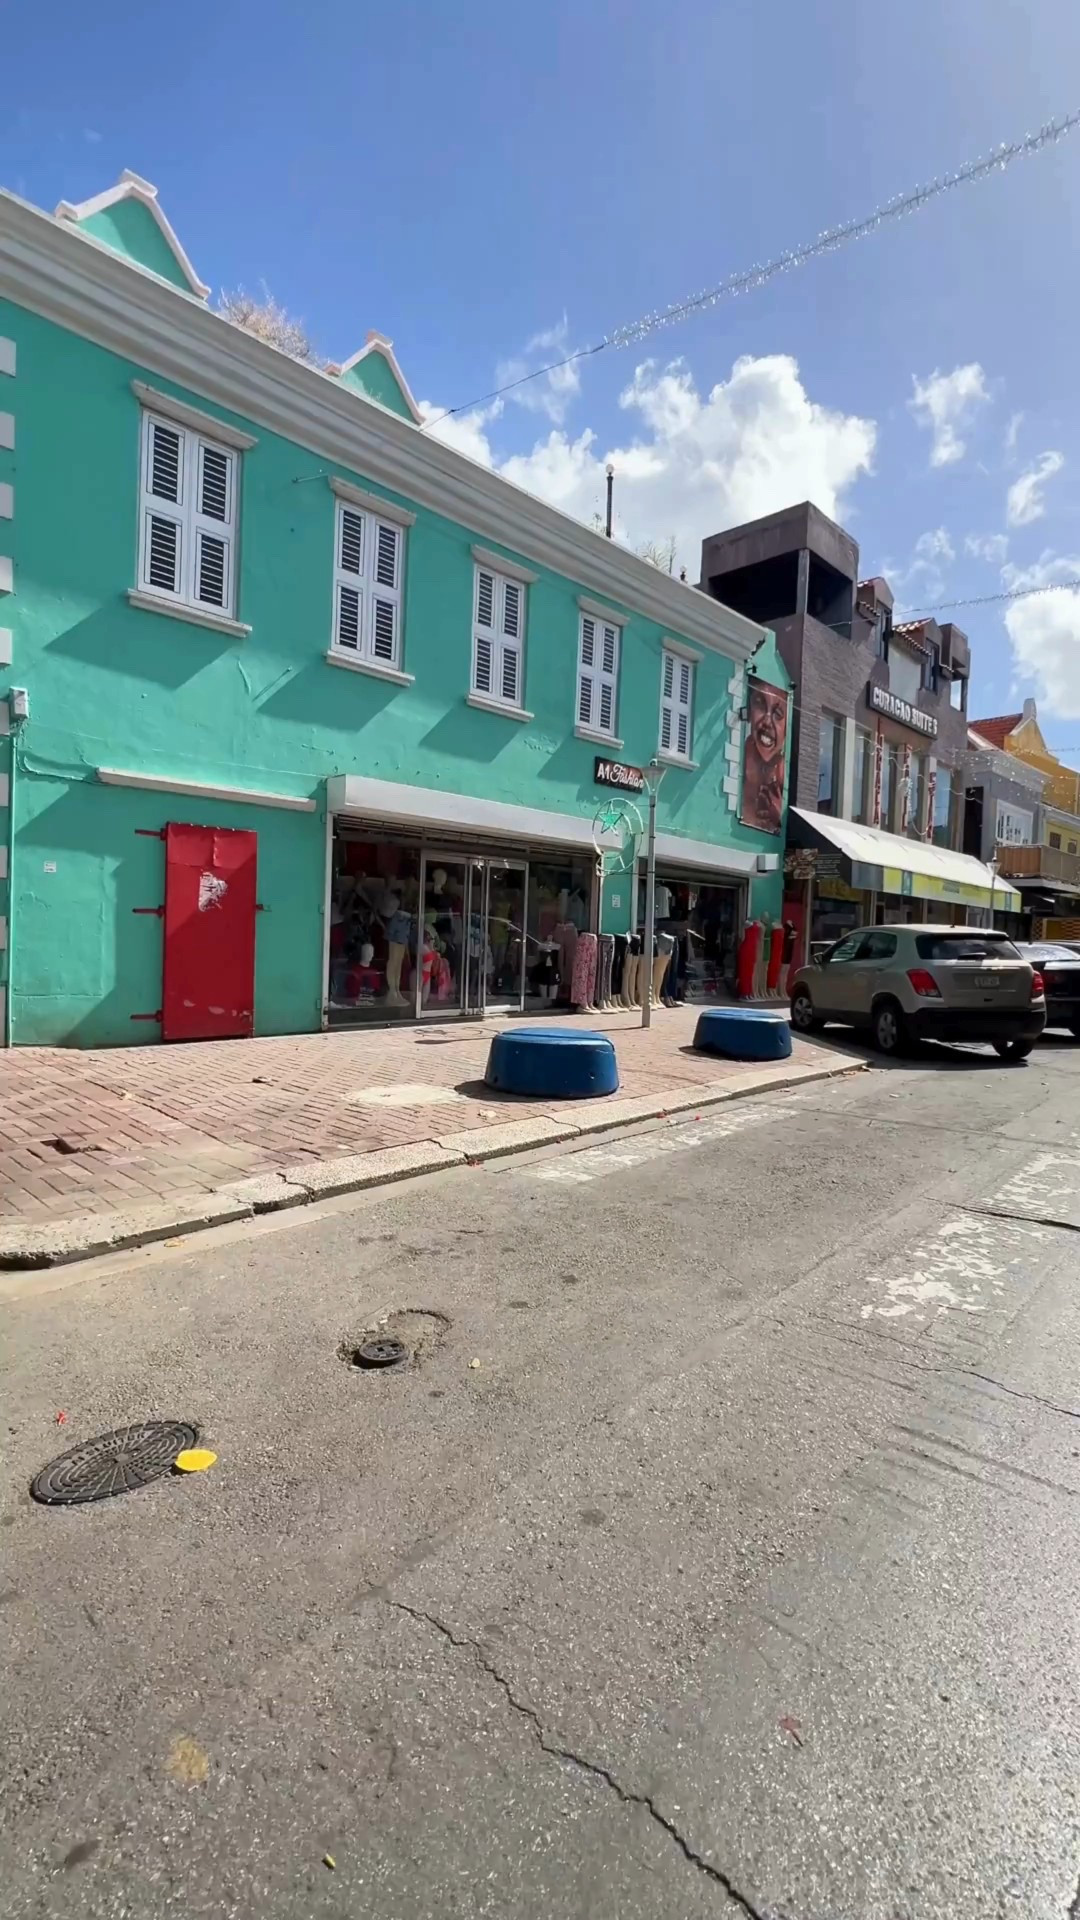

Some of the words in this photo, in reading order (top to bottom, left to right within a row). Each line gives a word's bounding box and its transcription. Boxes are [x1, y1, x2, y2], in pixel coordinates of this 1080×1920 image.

[873, 686, 911, 722] CURACAO
[911, 707, 938, 735] SUITES
[597, 762, 610, 780] A1
[610, 763, 645, 789] Fashion
